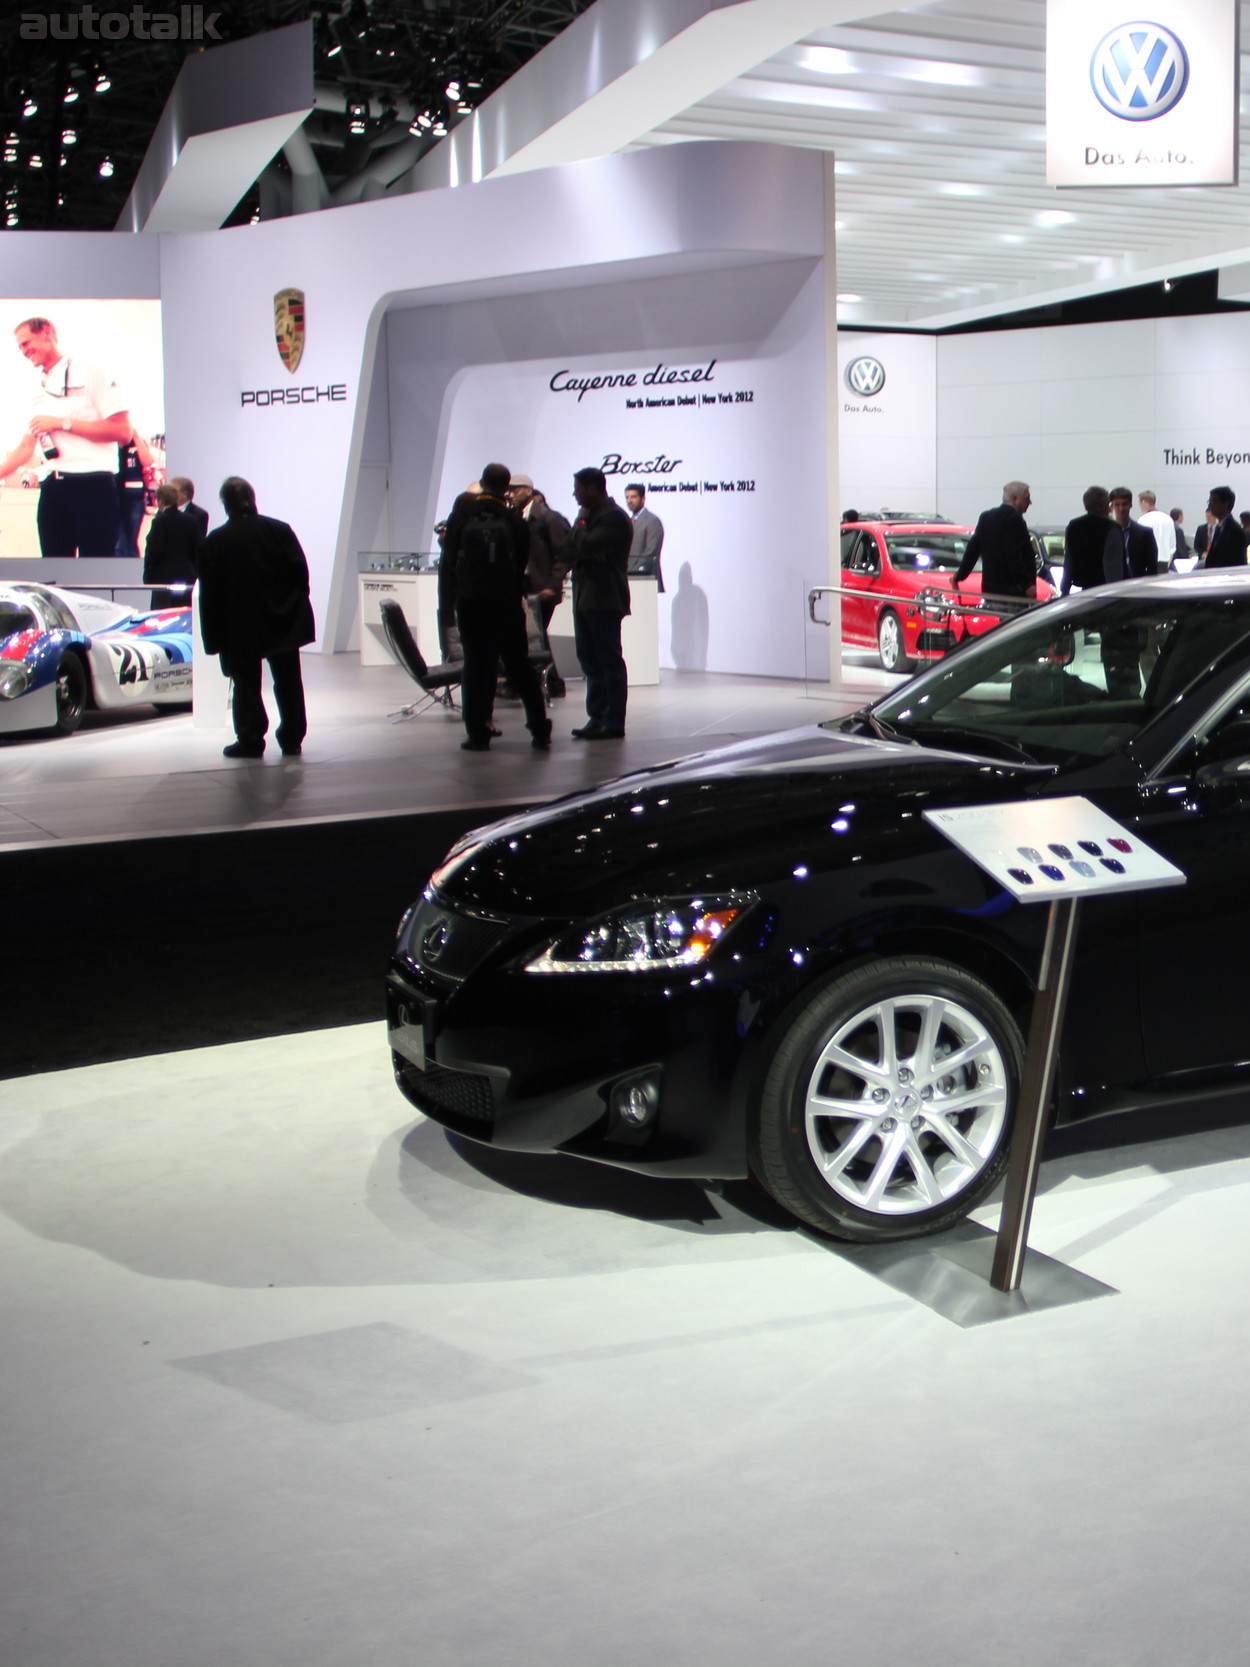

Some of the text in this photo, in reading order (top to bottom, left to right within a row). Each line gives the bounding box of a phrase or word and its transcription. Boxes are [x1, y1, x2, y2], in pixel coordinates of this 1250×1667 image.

[1084, 146, 1126, 166] Das
[549, 359, 717, 403] Cayenne diesel
[241, 384, 347, 407] PORSCHE
[645, 397, 676, 408] American
[701, 393, 717, 404] New
[717, 391, 734, 404] York
[734, 390, 755, 403] 2012
[600, 453, 683, 475] Boxster
[1163, 448, 1201, 466] Think
[703, 481, 719, 492] New
[719, 480, 735, 492] York
[736, 479, 756, 492] 2012
[111, 644, 150, 686] 21
